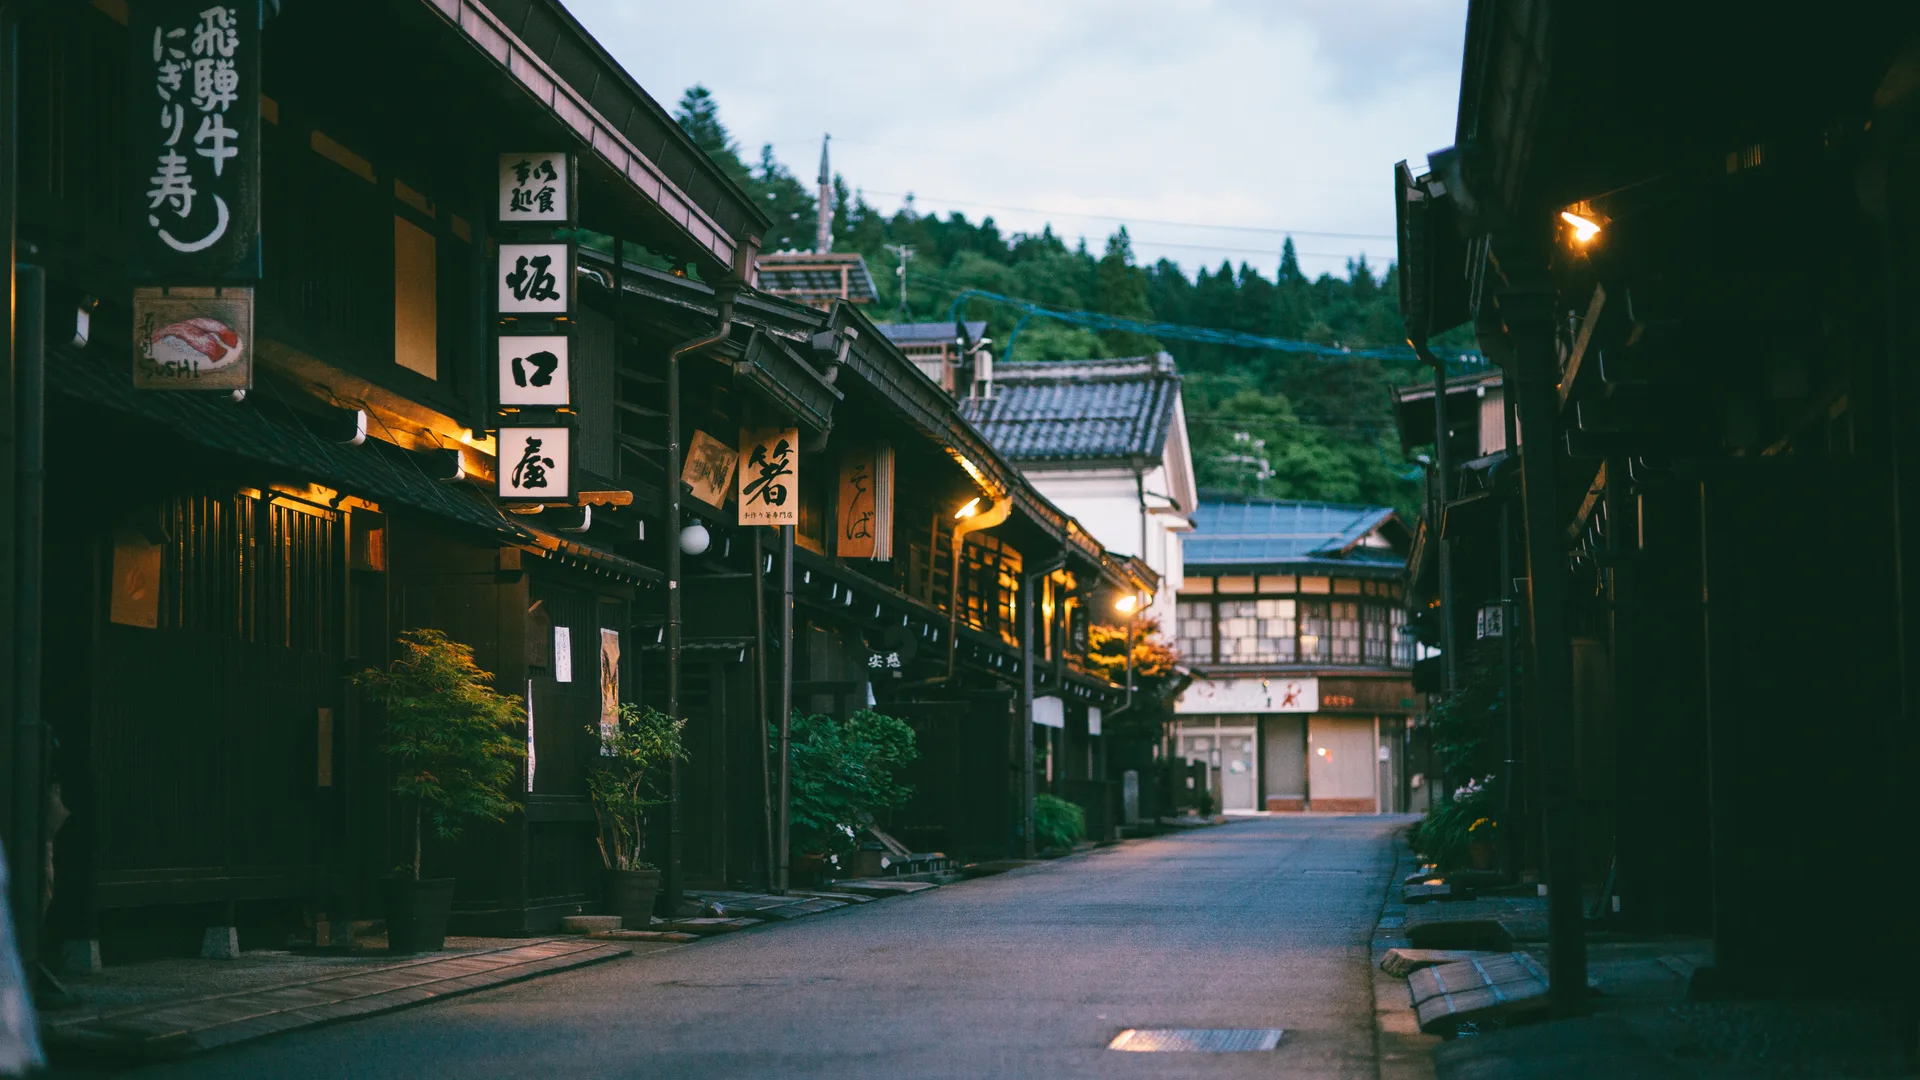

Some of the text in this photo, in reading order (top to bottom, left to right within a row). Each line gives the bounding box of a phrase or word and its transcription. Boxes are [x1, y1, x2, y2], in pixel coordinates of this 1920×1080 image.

[192, 5, 239, 177] 飛騨牛
[742, 438, 794, 507] 箸
[847, 464, 874, 540] そば
